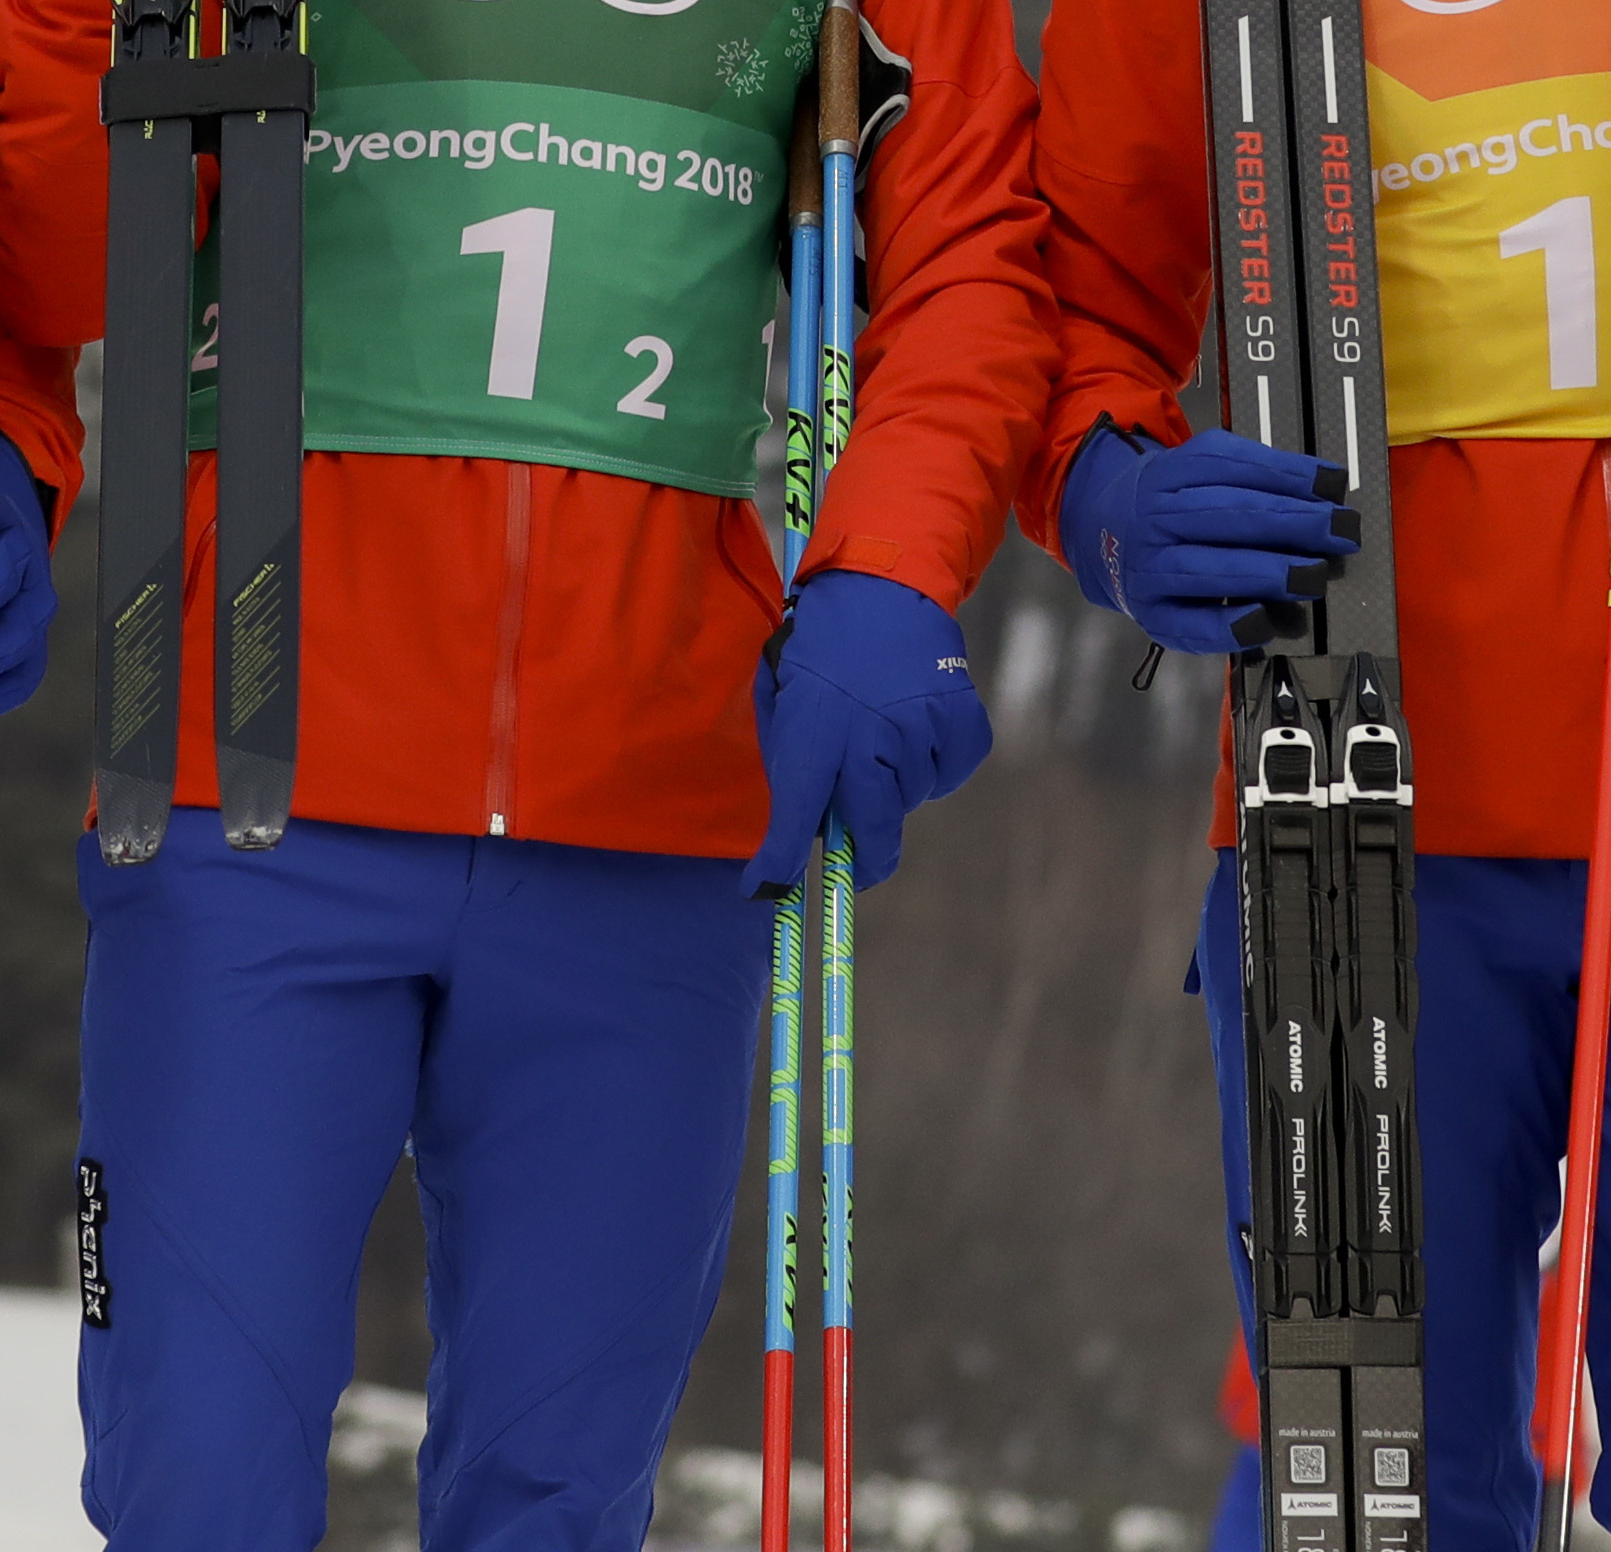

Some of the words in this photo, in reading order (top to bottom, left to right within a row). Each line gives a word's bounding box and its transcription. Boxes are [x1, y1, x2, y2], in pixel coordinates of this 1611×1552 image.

[304, 123, 666, 192] PyeongChang
[673, 149, 754, 206] 2018
[1234, 130, 1272, 305] REDSTER
[1319, 134, 1359, 309] REDSTER
[460, 207, 555, 400] 1
[1498, 195, 1598, 391] 1
[616, 335, 675, 420] 2
[1245, 315, 1276, 362] S9
[1332, 317, 1361, 364] S9
[787, 407, 812, 536] KV+
[1288, 1020, 1305, 1093] ATOMIC
[1371, 1017, 1387, 1089] ATOMIC
[81, 1165, 106, 1321] phenix
[1279, 1427, 1299, 1437] made
[1300, 1427, 1308, 1436] in
[1310, 1428, 1336, 1437] austria
[1362, 1428, 1382, 1438] made
[1384, 1429, 1391, 1438] in
[1393, 1429, 1419, 1439] austria
[1297, 1501, 1332, 1509] ATOMIC
[1380, 1502, 1415, 1510] ATOMIC
